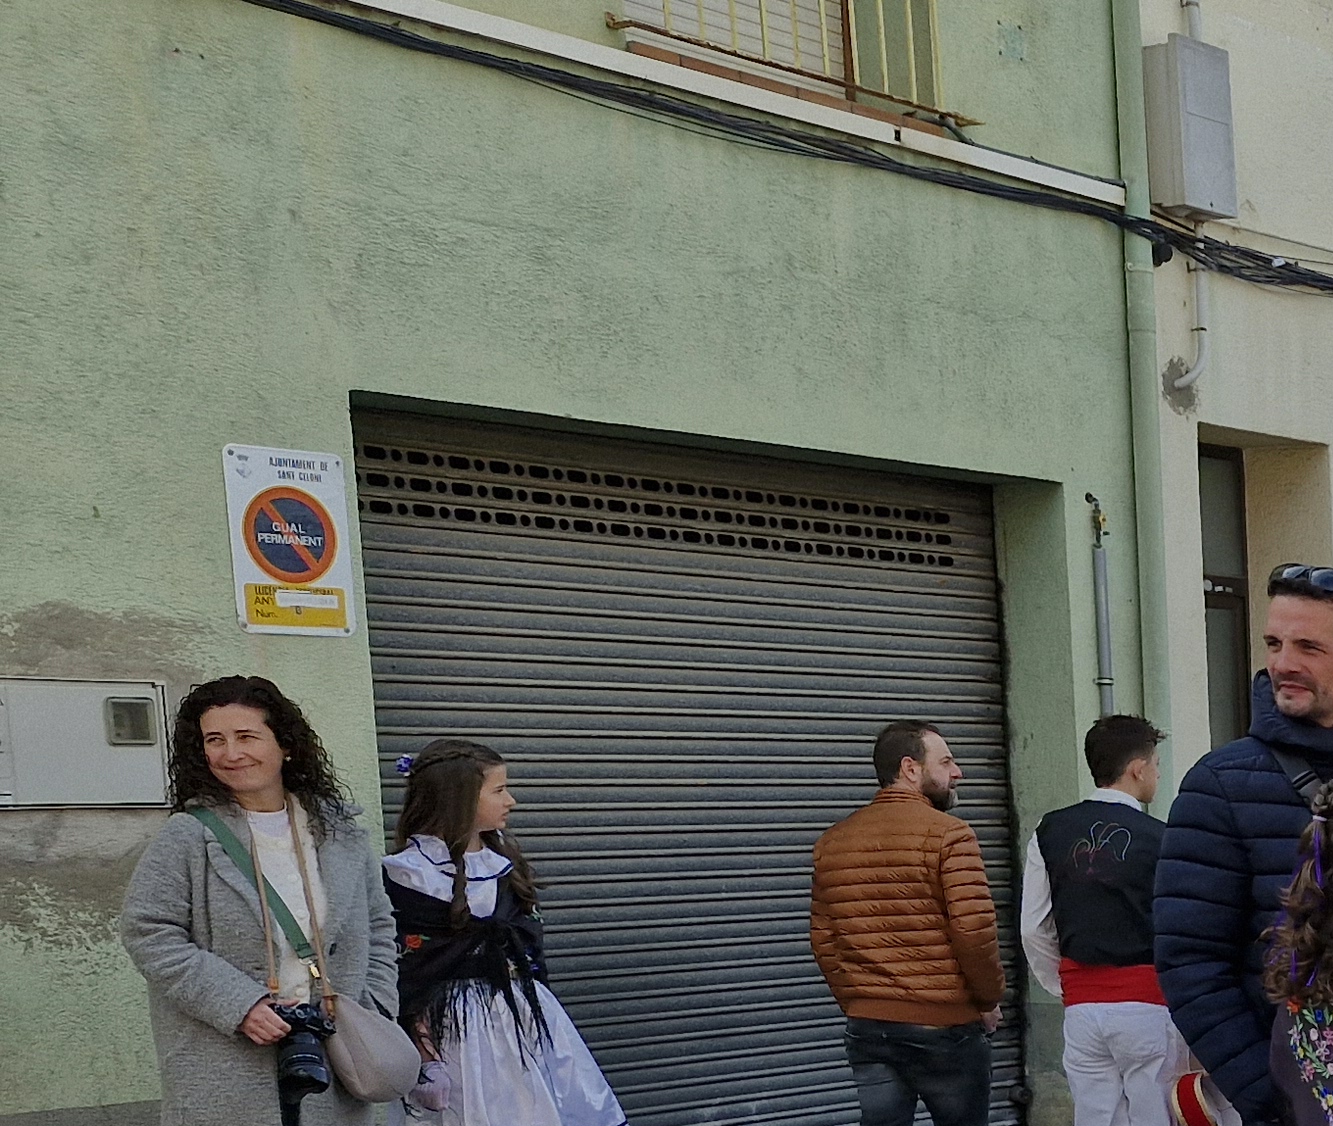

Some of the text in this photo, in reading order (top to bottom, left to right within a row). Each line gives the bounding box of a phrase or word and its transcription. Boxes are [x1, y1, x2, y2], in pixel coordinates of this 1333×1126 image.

[320, 461, 328, 472] DE
[272, 521, 306, 534] GUAL
[257, 532, 323, 547] PERMANENT
